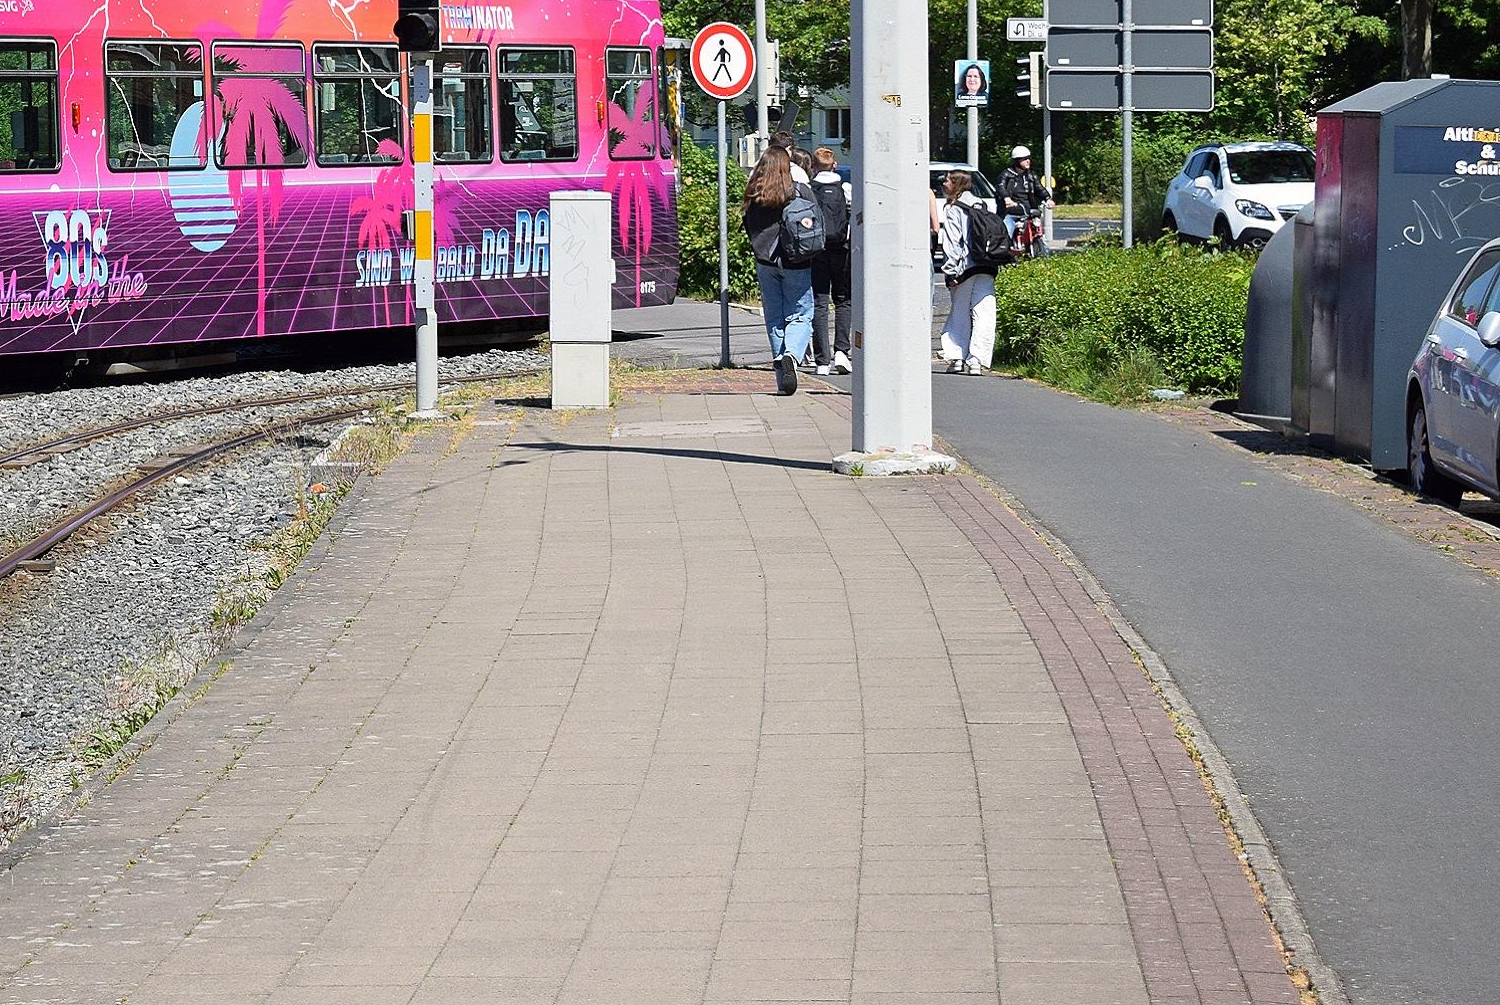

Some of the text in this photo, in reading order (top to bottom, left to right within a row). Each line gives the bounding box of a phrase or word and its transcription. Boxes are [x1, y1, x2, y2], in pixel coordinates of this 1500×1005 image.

[443, 5, 515, 31] TRAMINATOR
[1480, 144, 1496, 159] &
[1455, 160, 1500, 175] Schu
[45, 209, 109, 289] 80s
[355, 247, 392, 287] SIND
[436, 245, 475, 283] BALD
[480, 227, 510, 280] DA
[513, 207, 549, 278] DA
[74, 272, 105, 310] in
[108, 254, 148, 304] the
[640, 280, 656, 294] 8175
